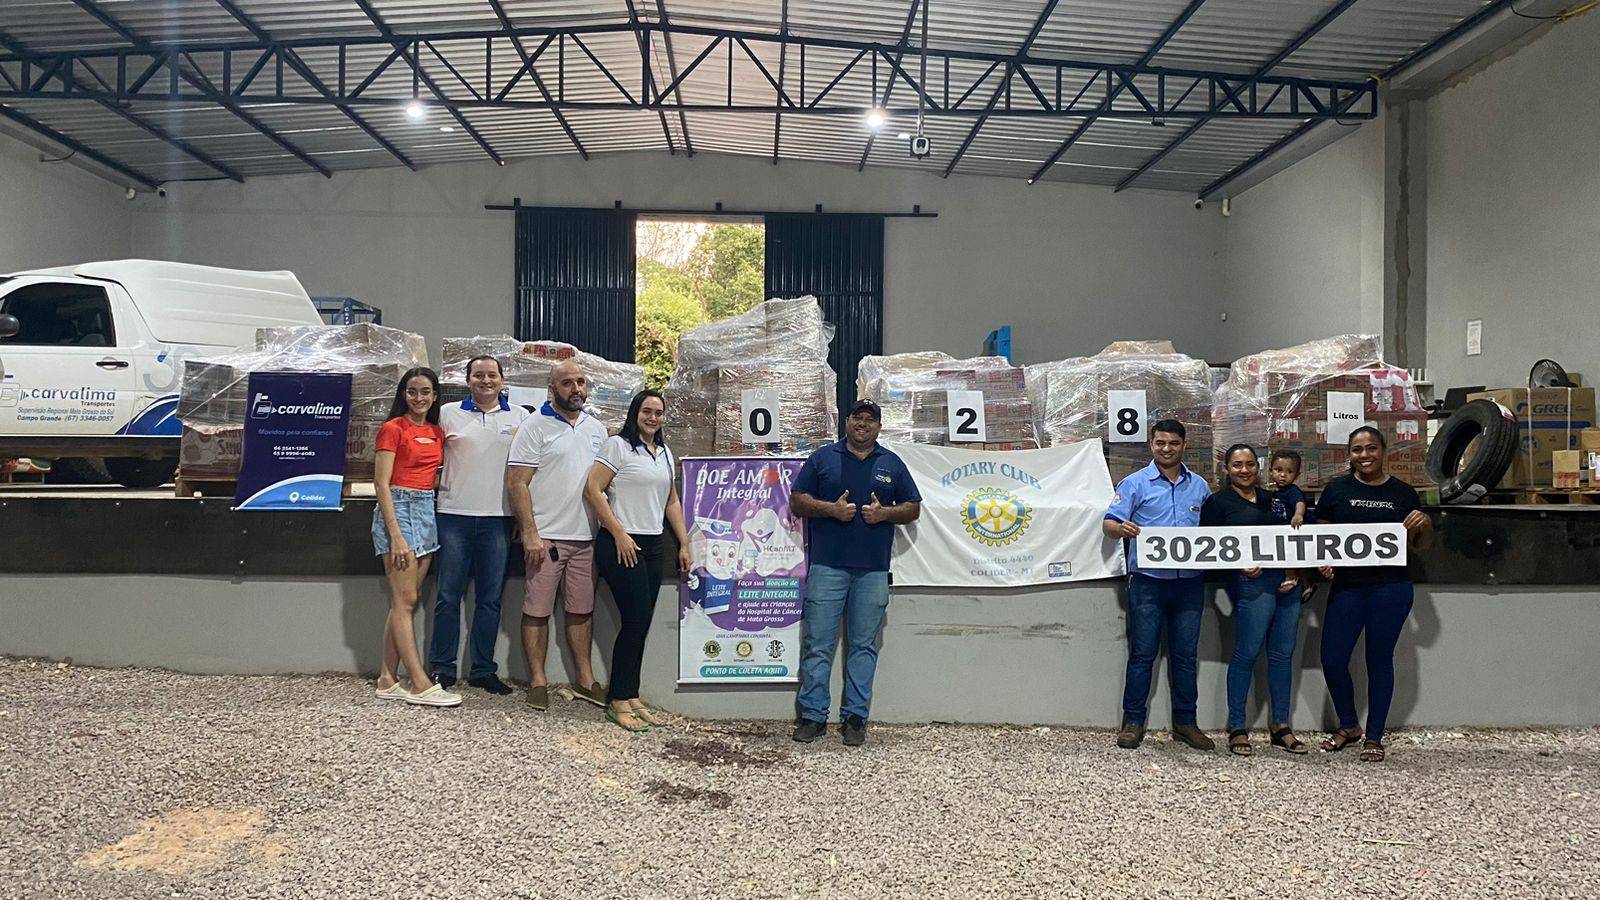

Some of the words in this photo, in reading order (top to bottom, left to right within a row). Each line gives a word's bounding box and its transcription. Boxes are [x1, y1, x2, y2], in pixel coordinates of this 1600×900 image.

[31, 387, 116, 401] carvalima
[277, 402, 343, 415] carvalima
[17, 415, 38, 423] Campo
[749, 408, 772, 436] 0
[956, 407, 978, 435] 2
[1116, 408, 1139, 436] 8
[1333, 412, 1359, 420] Litros
[258, 428, 286, 436] Movidos
[696, 469, 730, 485] DOE
[734, 469, 792, 485] AMR
[942, 461, 997, 488] ROTARY
[1000, 463, 1042, 490] CLUB
[717, 487, 772, 500] Integral
[975, 522, 1020, 539] INTERNATIONAL
[1145, 535, 1241, 562] 3028
[1250, 532, 1399, 562] LITROS
[737, 579, 752, 587] Faça
[766, 579, 788, 587] doação
[706, 590, 731, 598] INTEGRAL
[738, 590, 760, 598] LEITE
[761, 590, 798, 598] INTEGRAL
[747, 608, 772, 616] Hospital
[705, 667, 726, 675] PONTO
[738, 666, 762, 674] COLETA
[763, 666, 783, 674] AQUI!
